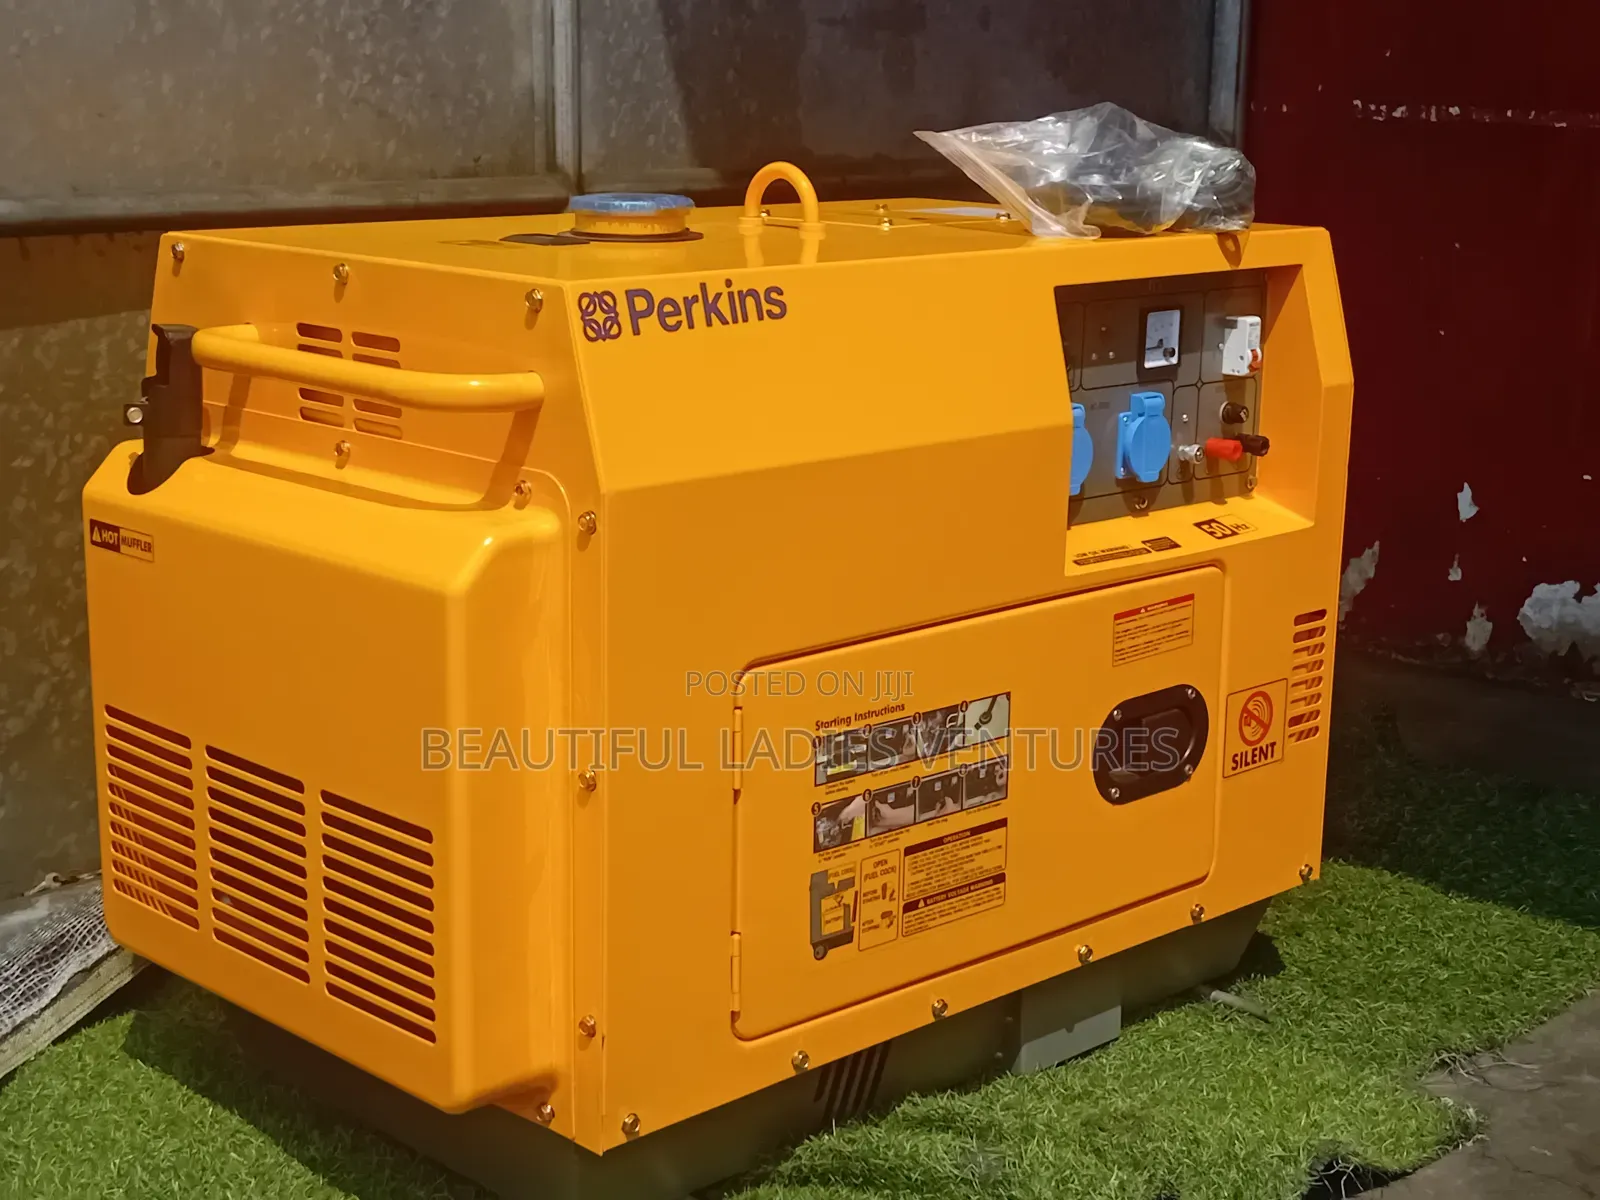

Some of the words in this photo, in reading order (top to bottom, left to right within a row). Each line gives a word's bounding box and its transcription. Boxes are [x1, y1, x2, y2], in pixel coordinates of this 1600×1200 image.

[625, 278, 787, 336] Perkins
[101, 529, 118, 546] HOT
[120, 535, 152, 553] MUFFLER
[1201, 521, 1233, 538] 50
[1231, 522, 1250, 532] Hz
[815, 716, 852, 731] Starting
[854, 703, 905, 722] Instructions
[1231, 742, 1277, 771] SILENT
[873, 859, 888, 869] OPEN
